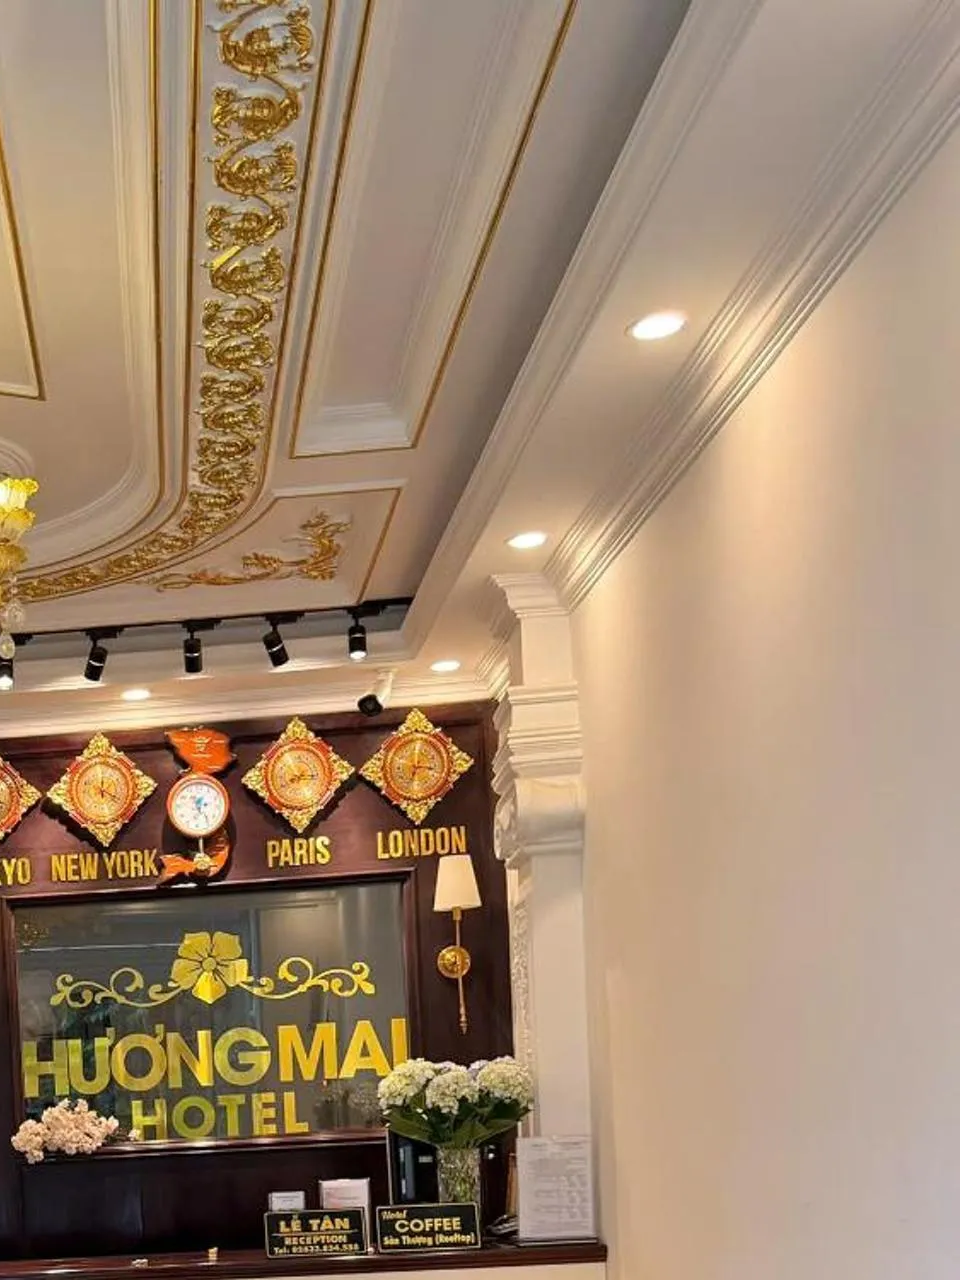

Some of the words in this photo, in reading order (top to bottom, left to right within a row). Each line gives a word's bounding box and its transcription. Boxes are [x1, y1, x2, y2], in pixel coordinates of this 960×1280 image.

[266, 835, 333, 869] PARIS
[376, 825, 467, 860] LONDON
[50, 851, 100, 882] NEW
[102, 847, 161, 880] YORK
[23, 1023, 272, 1099] HƯƠNG
[277, 1017, 410, 1083] MAI
[131, 1090, 310, 1142] HOTEL
[283, 1234, 349, 1246] RECEPTION
[308, 1214, 351, 1232] TÂN
[394, 1216, 462, 1233] COFFEE
